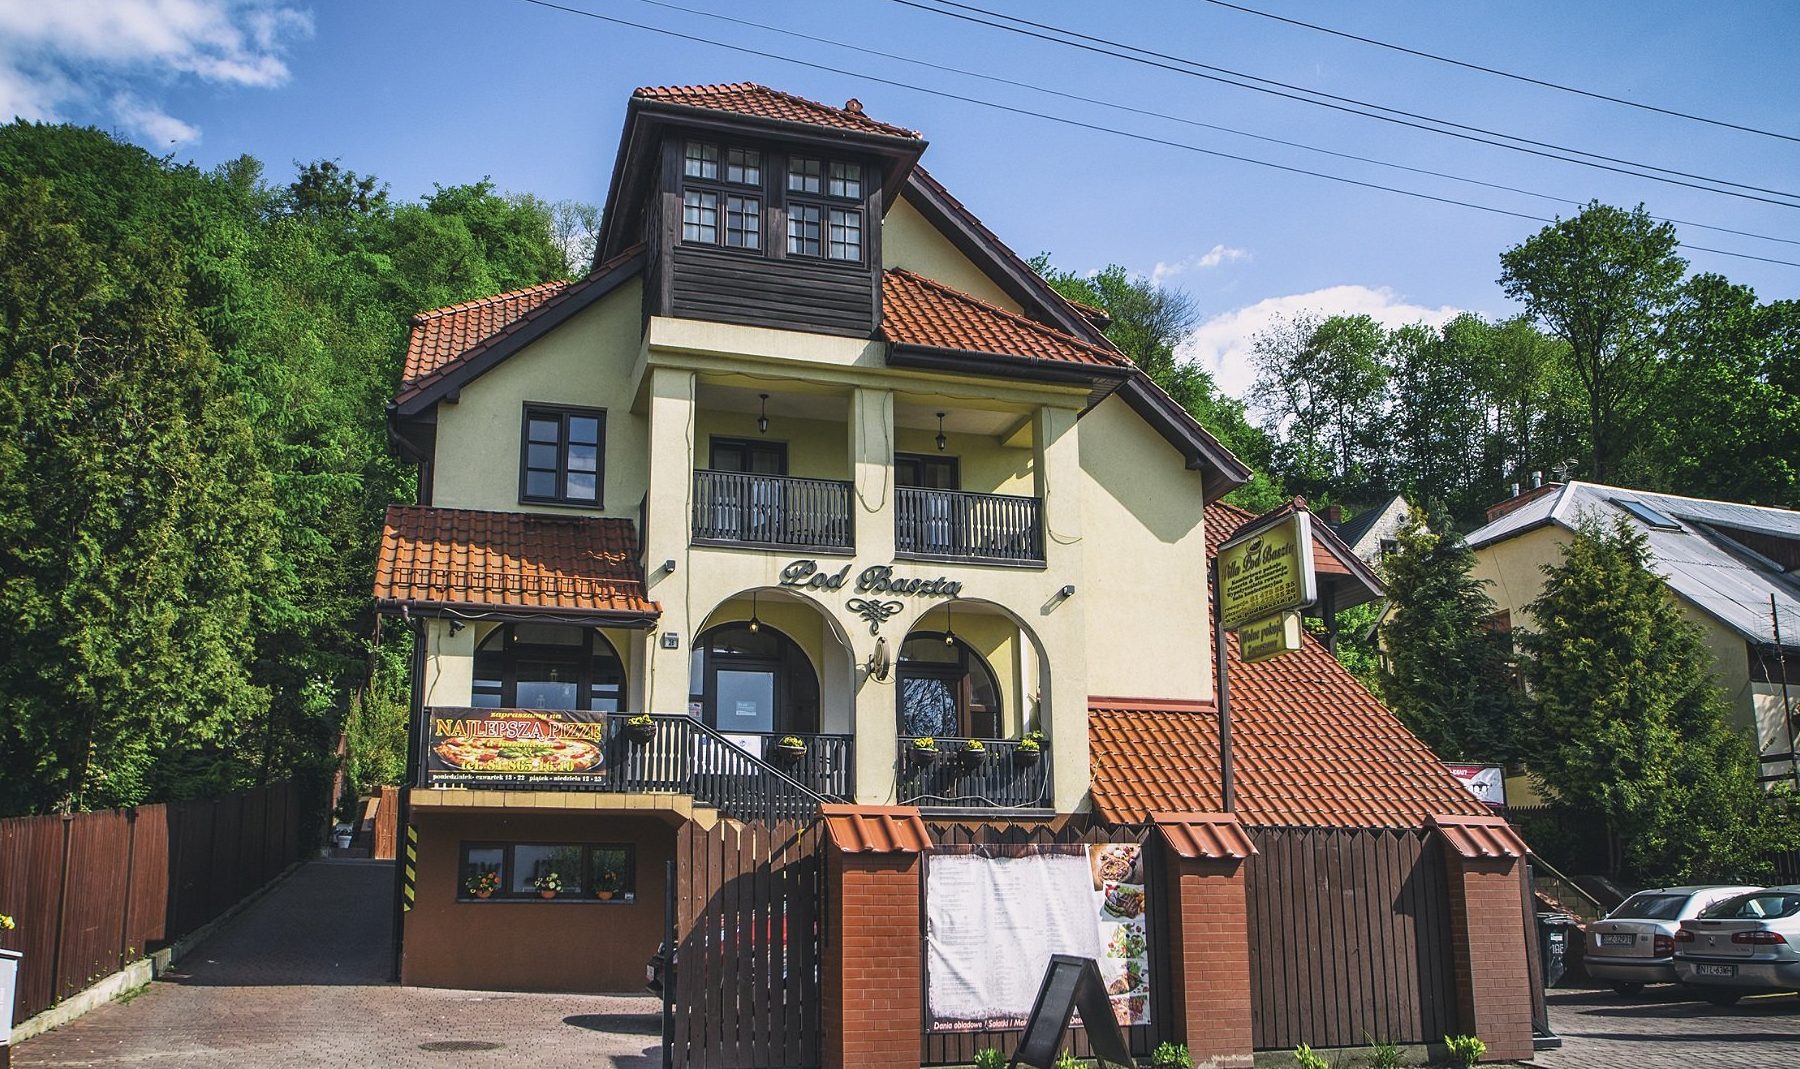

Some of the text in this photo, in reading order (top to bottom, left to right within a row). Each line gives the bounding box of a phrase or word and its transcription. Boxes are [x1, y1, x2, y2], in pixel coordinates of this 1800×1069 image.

[1243, 549, 1261, 573] Pod
[777, 560, 852, 591] Pod
[490, 711, 547, 720] zapraszamy
[435, 719, 602, 742] NAJLEPSZĄ PIZZĘ
[461, 760, 483, 770] tel.
[933, 1021, 953, 1030] Dania
[954, 1020, 983, 1030] obiadowe
